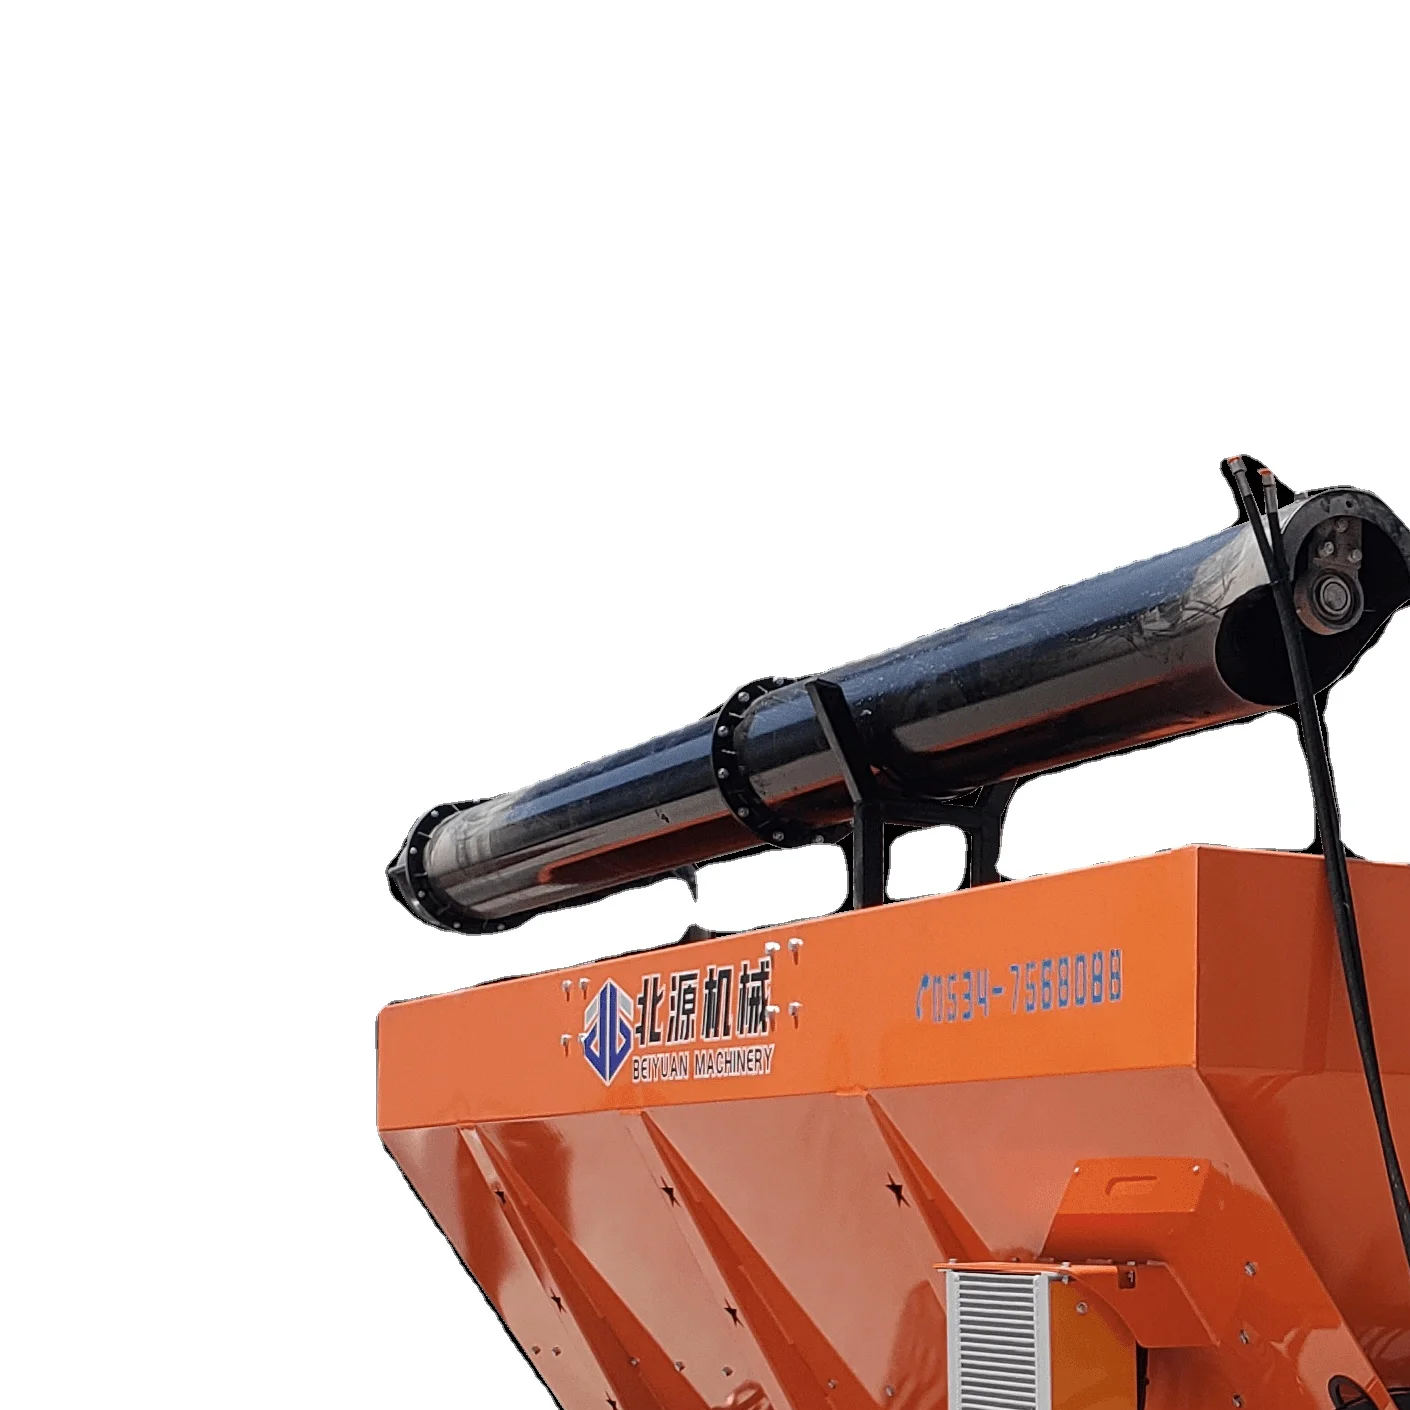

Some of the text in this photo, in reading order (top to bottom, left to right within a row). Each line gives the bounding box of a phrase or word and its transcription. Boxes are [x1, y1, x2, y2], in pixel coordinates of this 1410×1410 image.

[635, 957, 772, 1047] 北源机械
[932, 949, 1121, 1022] 0534-7568088
[633, 1044, 774, 1082] BEIYUAN MACHINERY
